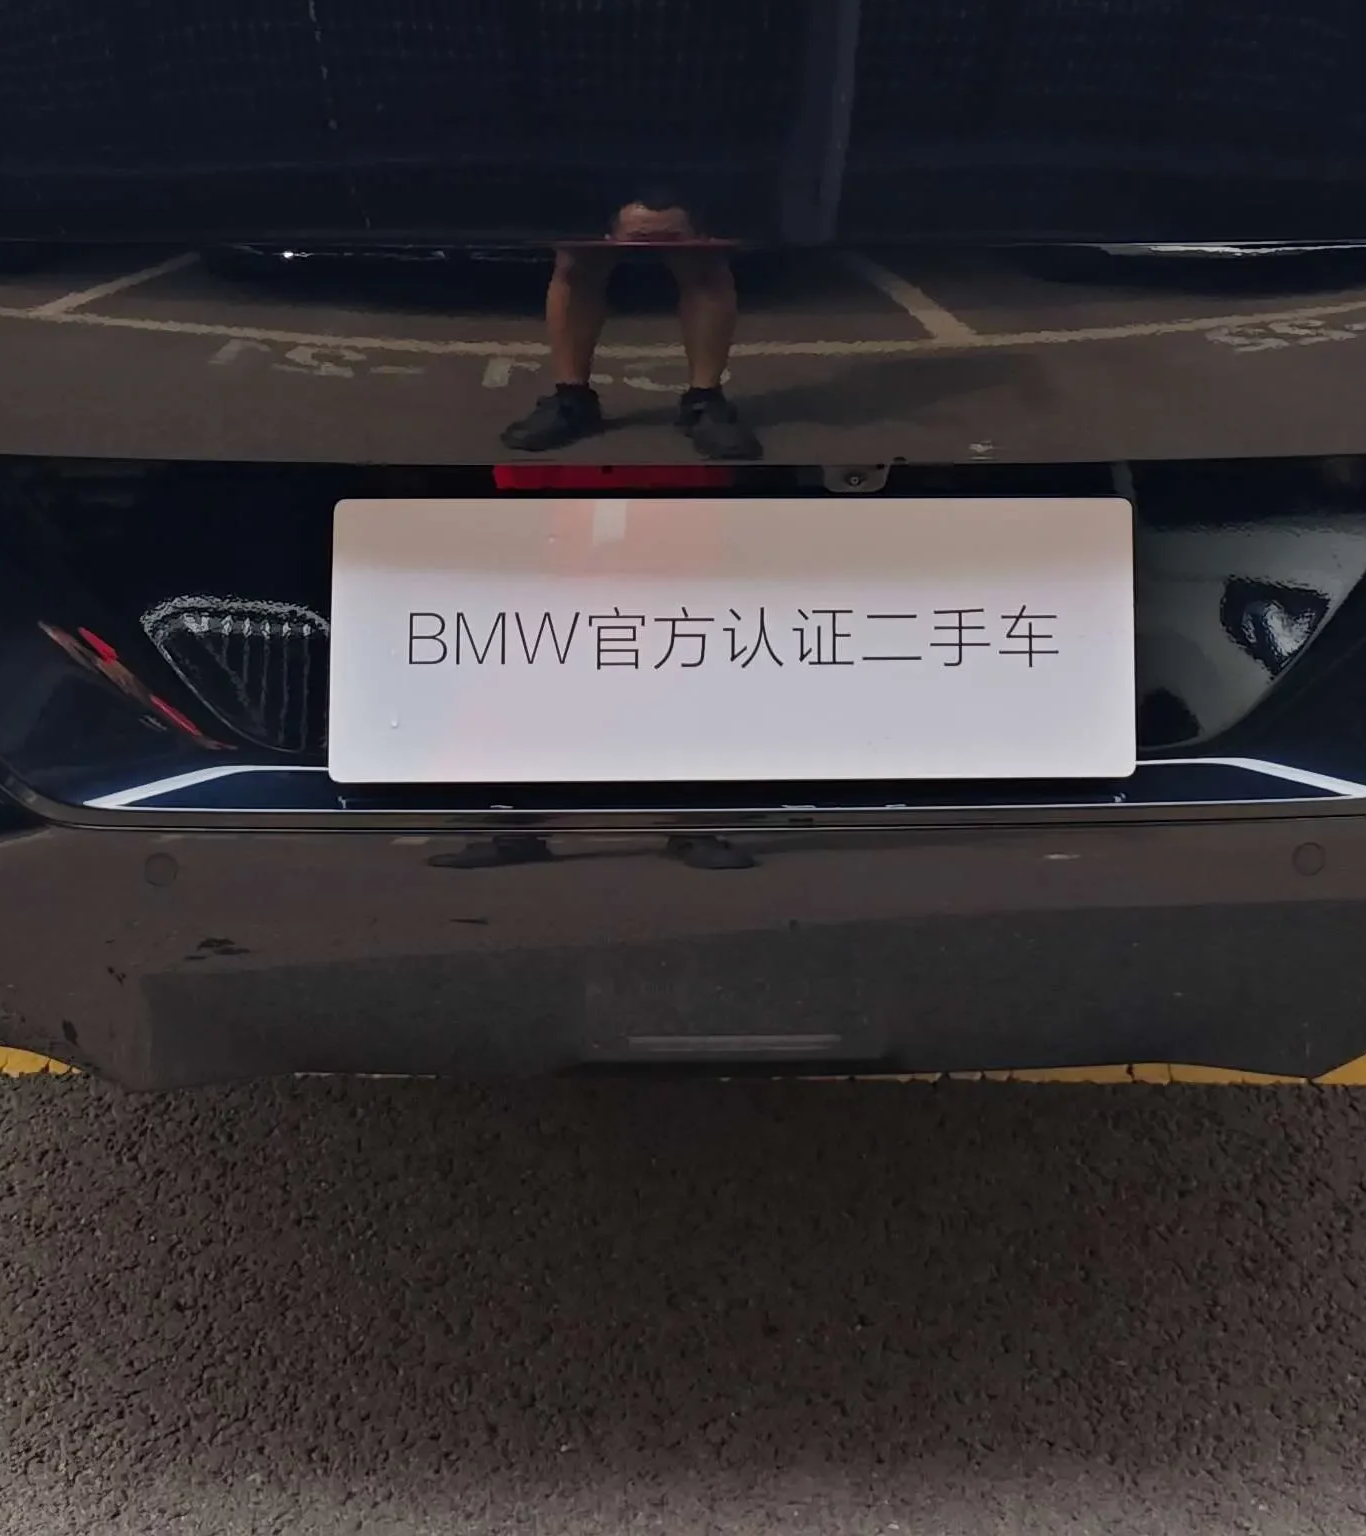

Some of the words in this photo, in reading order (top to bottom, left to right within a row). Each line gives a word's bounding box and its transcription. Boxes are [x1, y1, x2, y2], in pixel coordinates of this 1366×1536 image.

[407, 606, 1060, 670] BMW官方认证二手车
